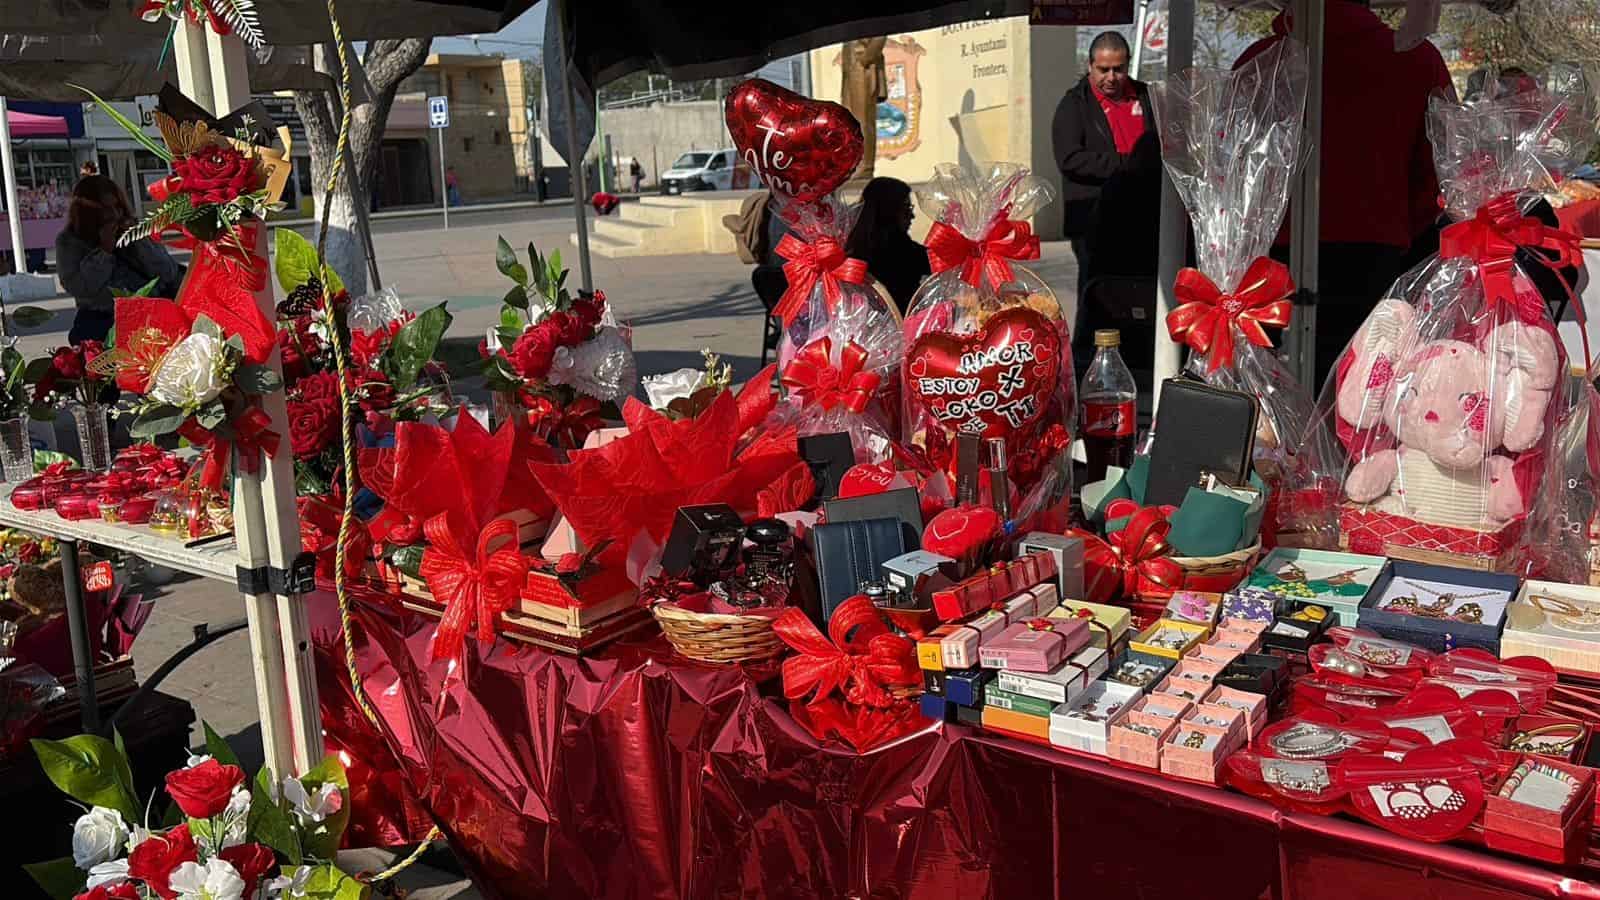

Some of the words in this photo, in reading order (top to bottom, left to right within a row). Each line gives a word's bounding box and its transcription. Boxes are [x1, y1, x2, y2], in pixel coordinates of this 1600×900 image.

[755, 118, 793, 170] Te
[956, 341, 1033, 375] AMOR
[920, 377, 980, 395] ESTOY
[931, 391, 998, 422] LOKO
